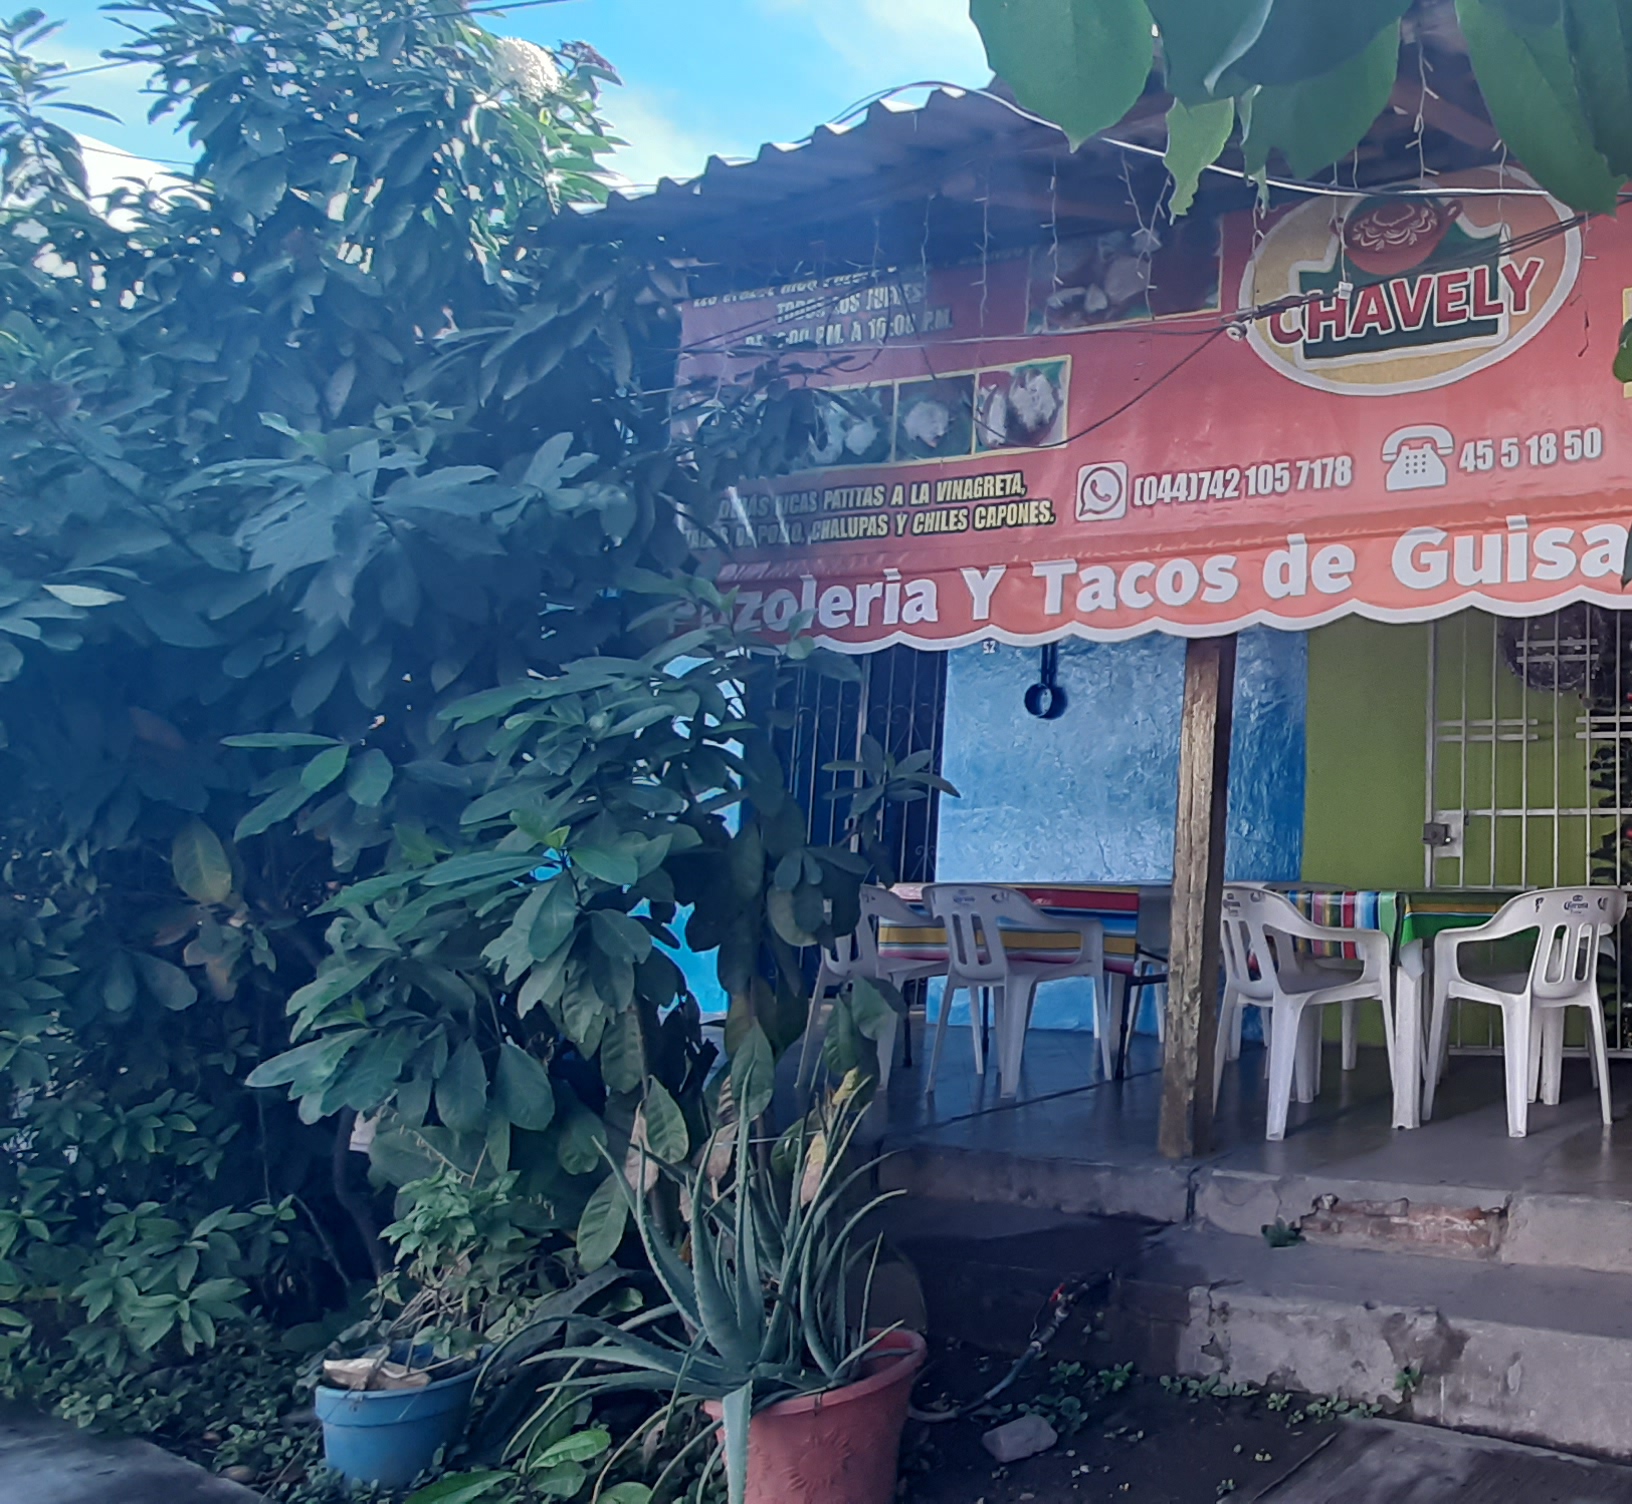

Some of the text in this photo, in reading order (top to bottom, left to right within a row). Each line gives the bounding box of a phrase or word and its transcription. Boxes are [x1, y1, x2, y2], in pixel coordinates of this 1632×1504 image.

[1268, 256, 1544, 347] CHAVELY
[1459, 426, 1601, 472] 45 5 18 50
[823, 484, 885, 511] PATITAS
[890, 485, 904, 506] A
[911, 482, 931, 504] LA
[936, 471, 1027, 503] VINAGRETA,
[1134, 455, 1352, 506] (044)742 105 7178
[811, 515, 889, 541] CHALUPAS
[897, 513, 908, 536] Y
[912, 508, 968, 536] CHILES
[974, 500, 1055, 530] CAPONES.
[960, 565, 1006, 621] Y
[1031, 553, 1239, 615] Tacos
[1262, 533, 1356, 600] de
